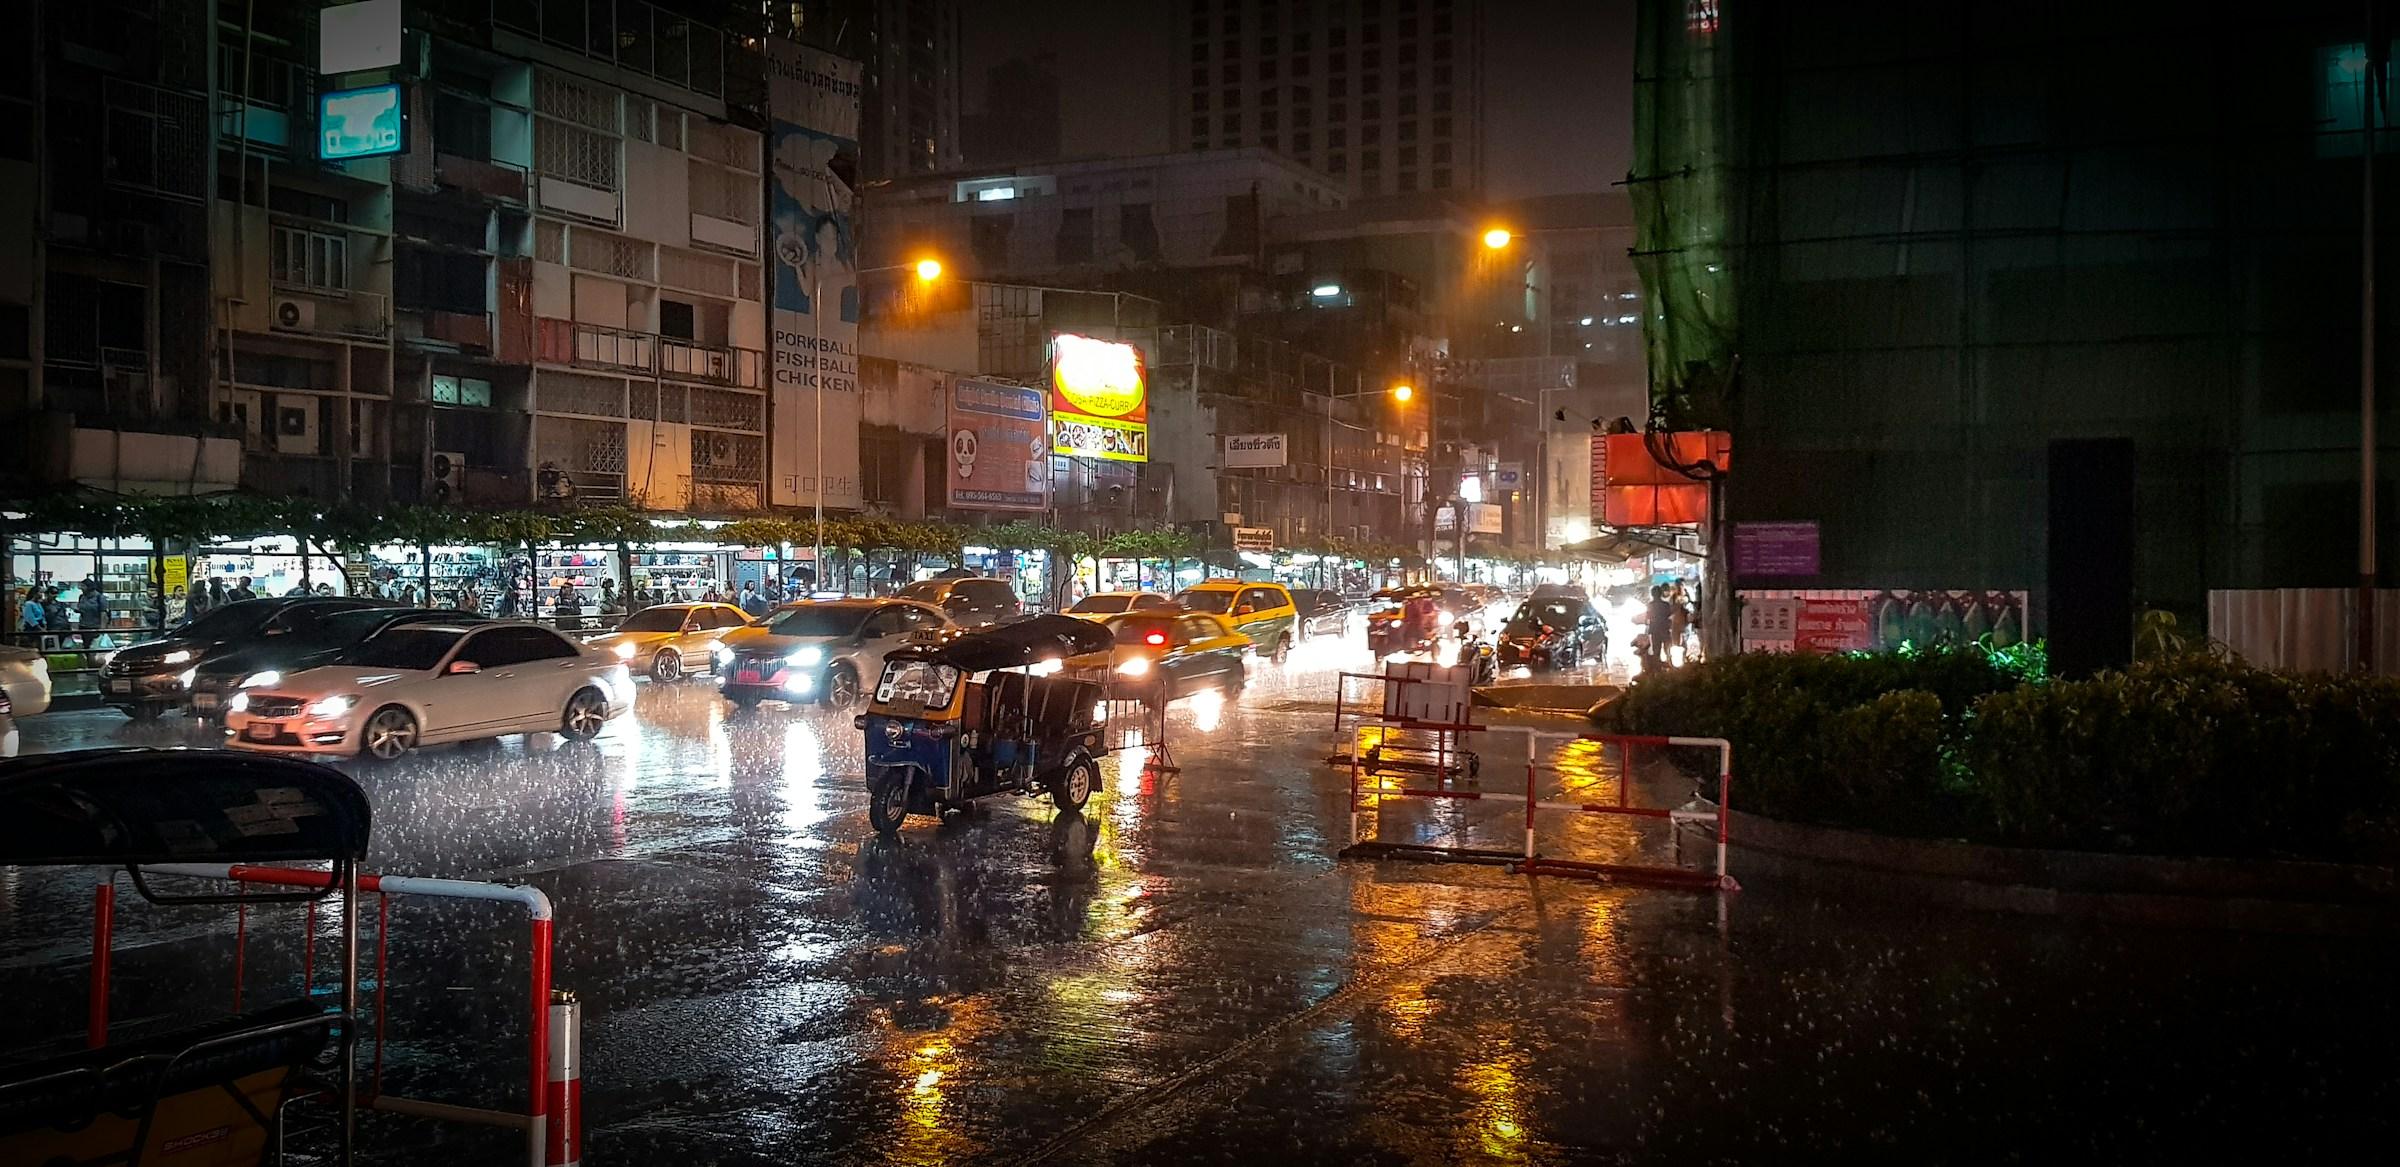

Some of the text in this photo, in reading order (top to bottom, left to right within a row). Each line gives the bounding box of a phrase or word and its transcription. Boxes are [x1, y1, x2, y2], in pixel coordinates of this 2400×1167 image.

[775, 330, 856, 356] PORK BALL
[775, 350, 856, 375] FISH BALL
[775, 369, 855, 392] CHICKEN
[914, 631, 935, 641] TAXI
